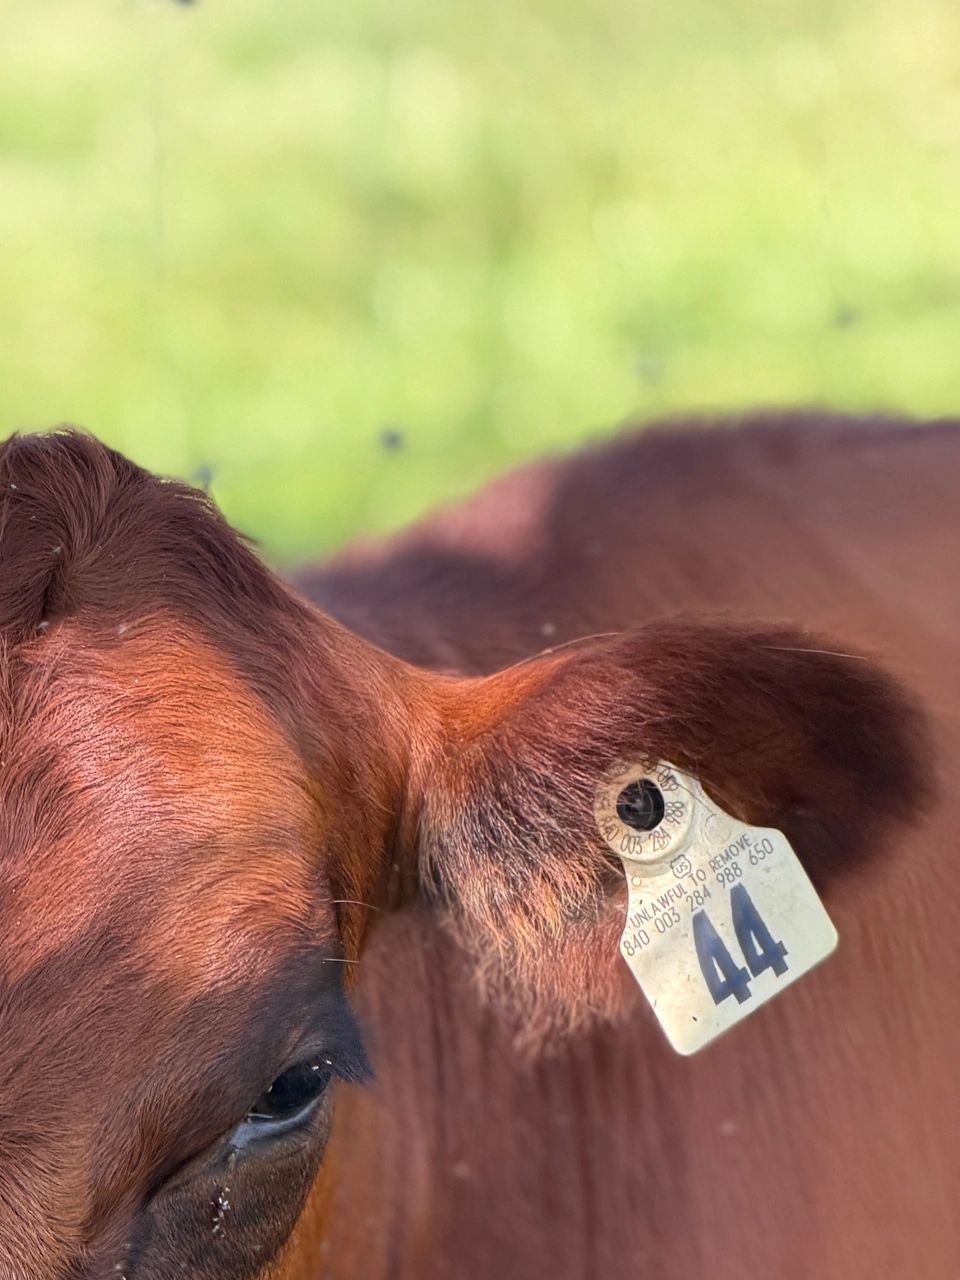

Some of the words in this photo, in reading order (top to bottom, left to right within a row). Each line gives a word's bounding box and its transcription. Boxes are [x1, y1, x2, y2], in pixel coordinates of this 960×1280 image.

[620, 832, 643, 855] 003
[665, 801, 685, 825] 988
[630, 883, 688, 929] UNLAWFUL
[689, 868, 707, 887] TO
[708, 833, 753, 873] REMOVE
[623, 929, 650, 957] 840
[654, 906, 681, 934] 003
[685, 884, 712, 912] 284
[716, 861, 743, 889] 988
[748, 838, 774, 866] 650
[692, 881, 789, 1006] 44
